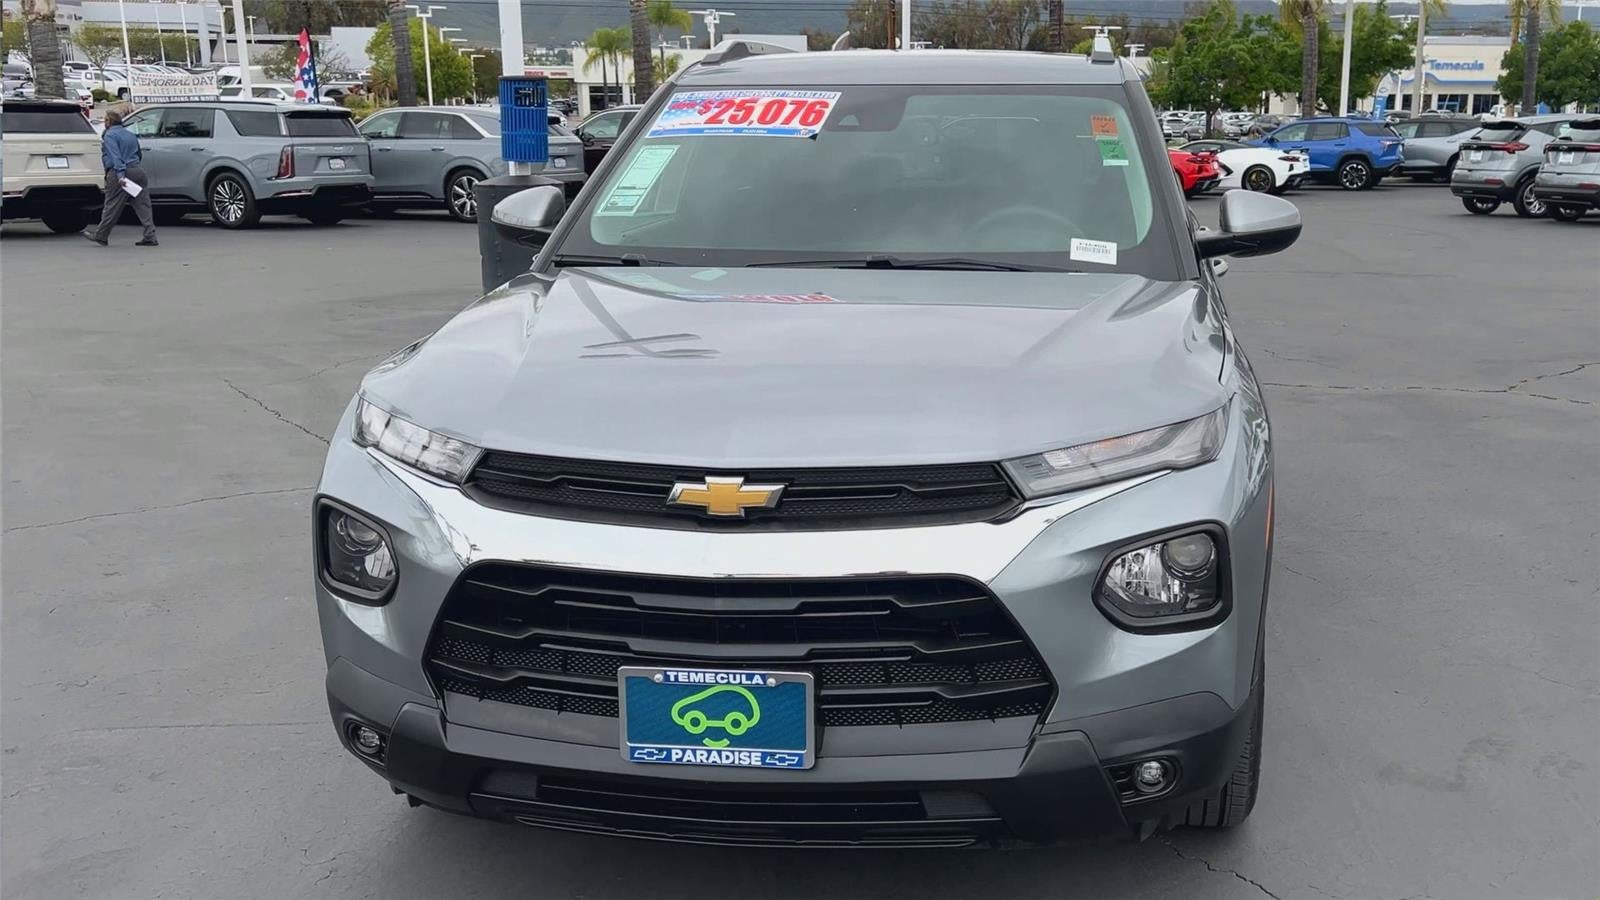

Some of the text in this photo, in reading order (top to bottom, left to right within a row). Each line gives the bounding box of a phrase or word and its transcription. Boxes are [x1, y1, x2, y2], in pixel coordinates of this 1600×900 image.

[1428, 59, 1484, 71] Temecula
[132, 75, 214, 87] MEMORIAL DAY
[696, 98, 829, 127] $25,076
[666, 671, 764, 685] TEMECULA
[670, 749, 763, 766] PARADISE
